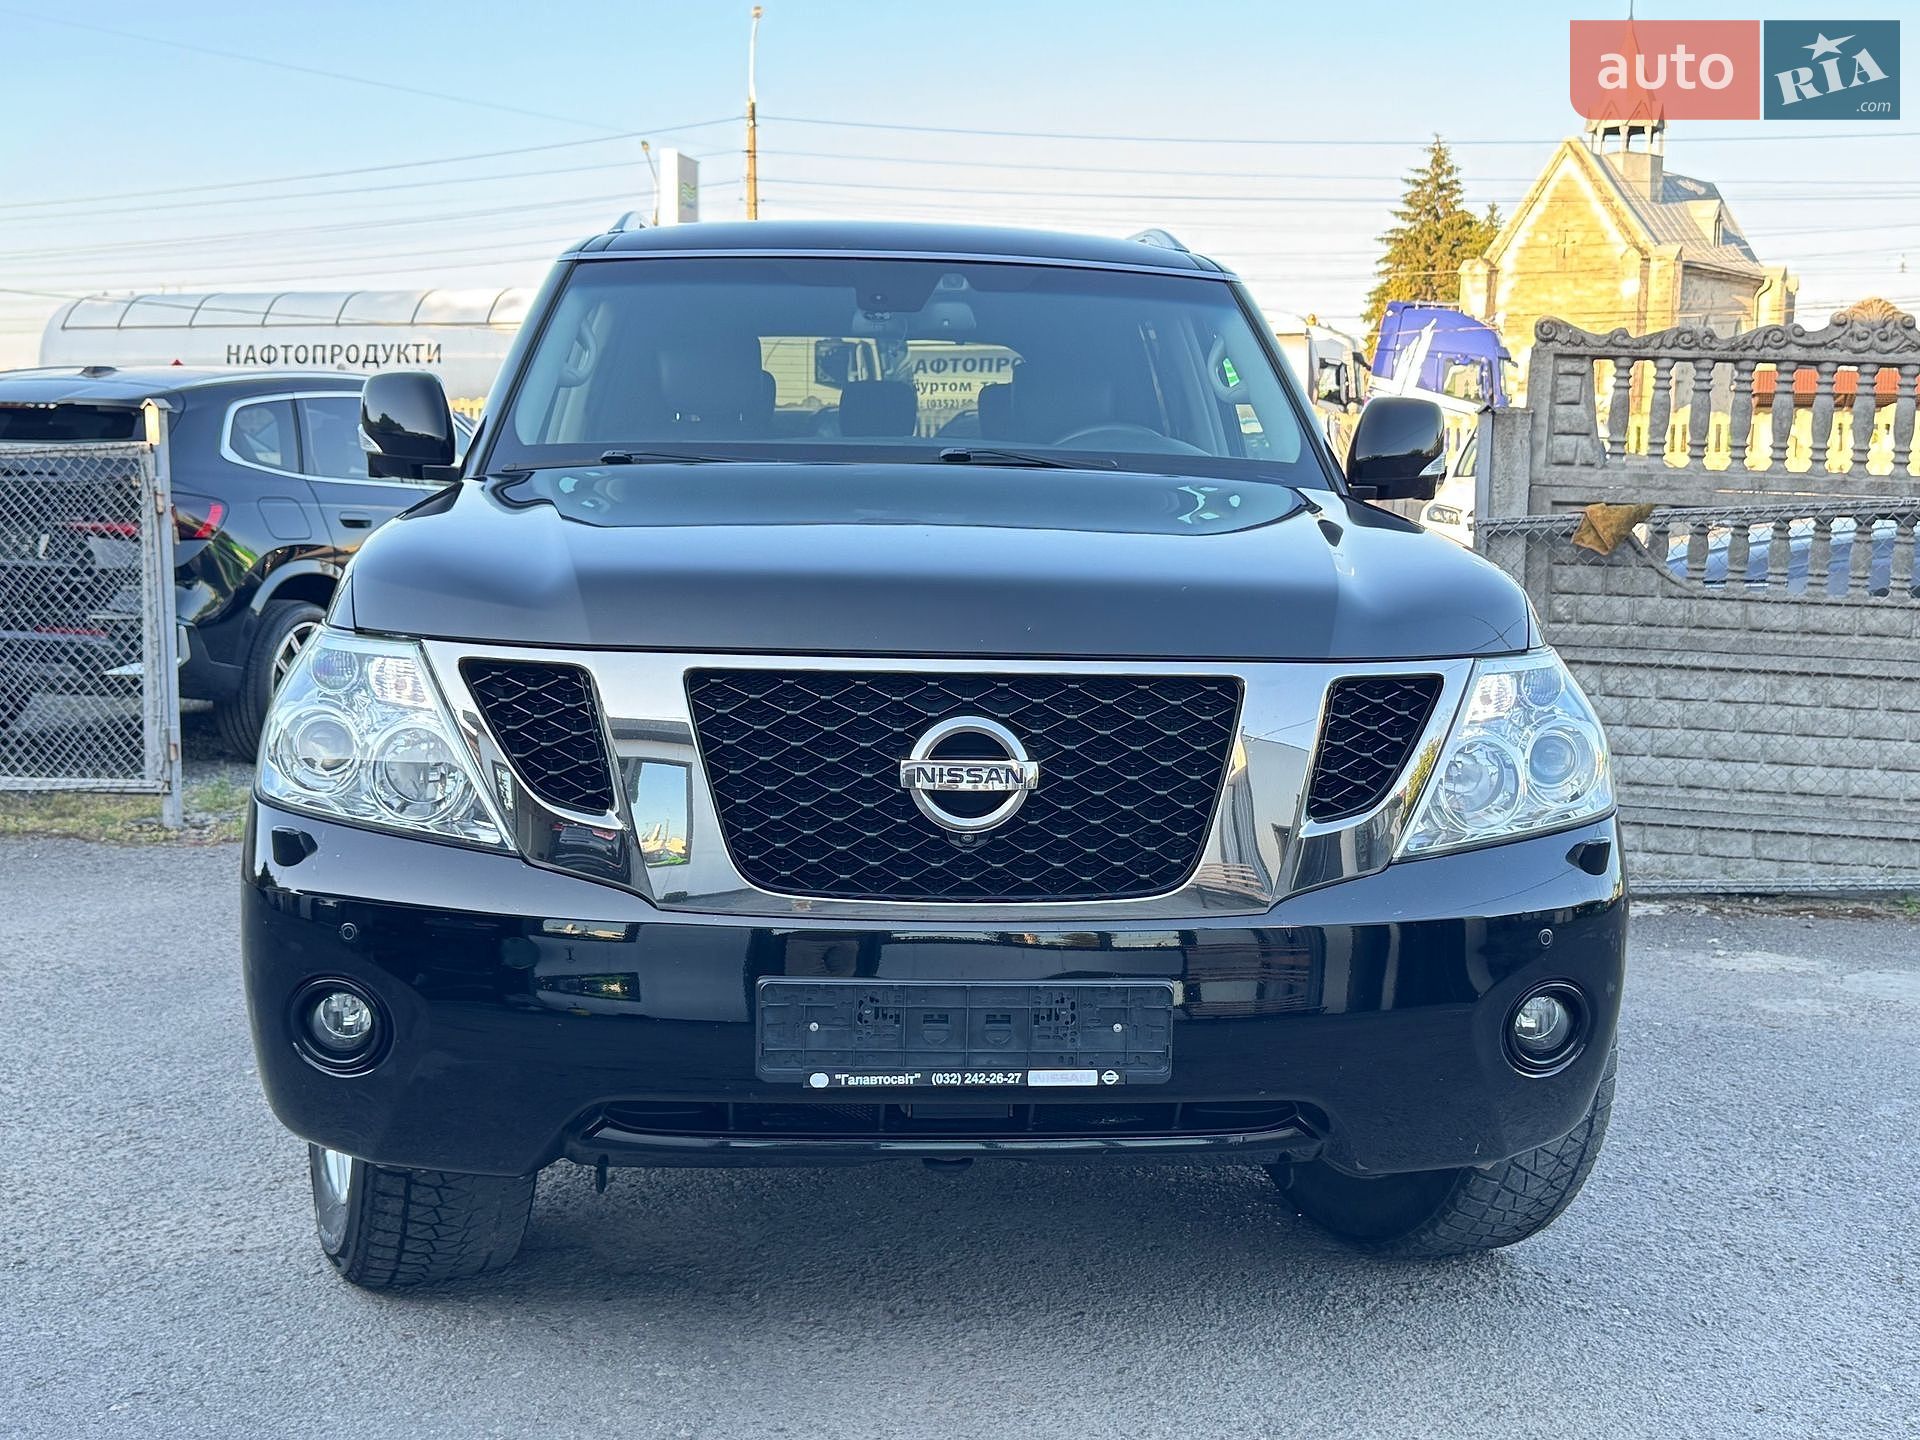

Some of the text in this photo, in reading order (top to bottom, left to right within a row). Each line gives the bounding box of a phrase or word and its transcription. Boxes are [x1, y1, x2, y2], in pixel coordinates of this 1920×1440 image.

[226, 343, 442, 368] НАФТОПРОДУКТИ
[916, 767, 1024, 784] NISSAN
[835, 1073, 921, 1086] "Галавтосвіт"
[931, 1073, 962, 1086] (032)
[964, 1073, 1022, 1085] 242-26-27
